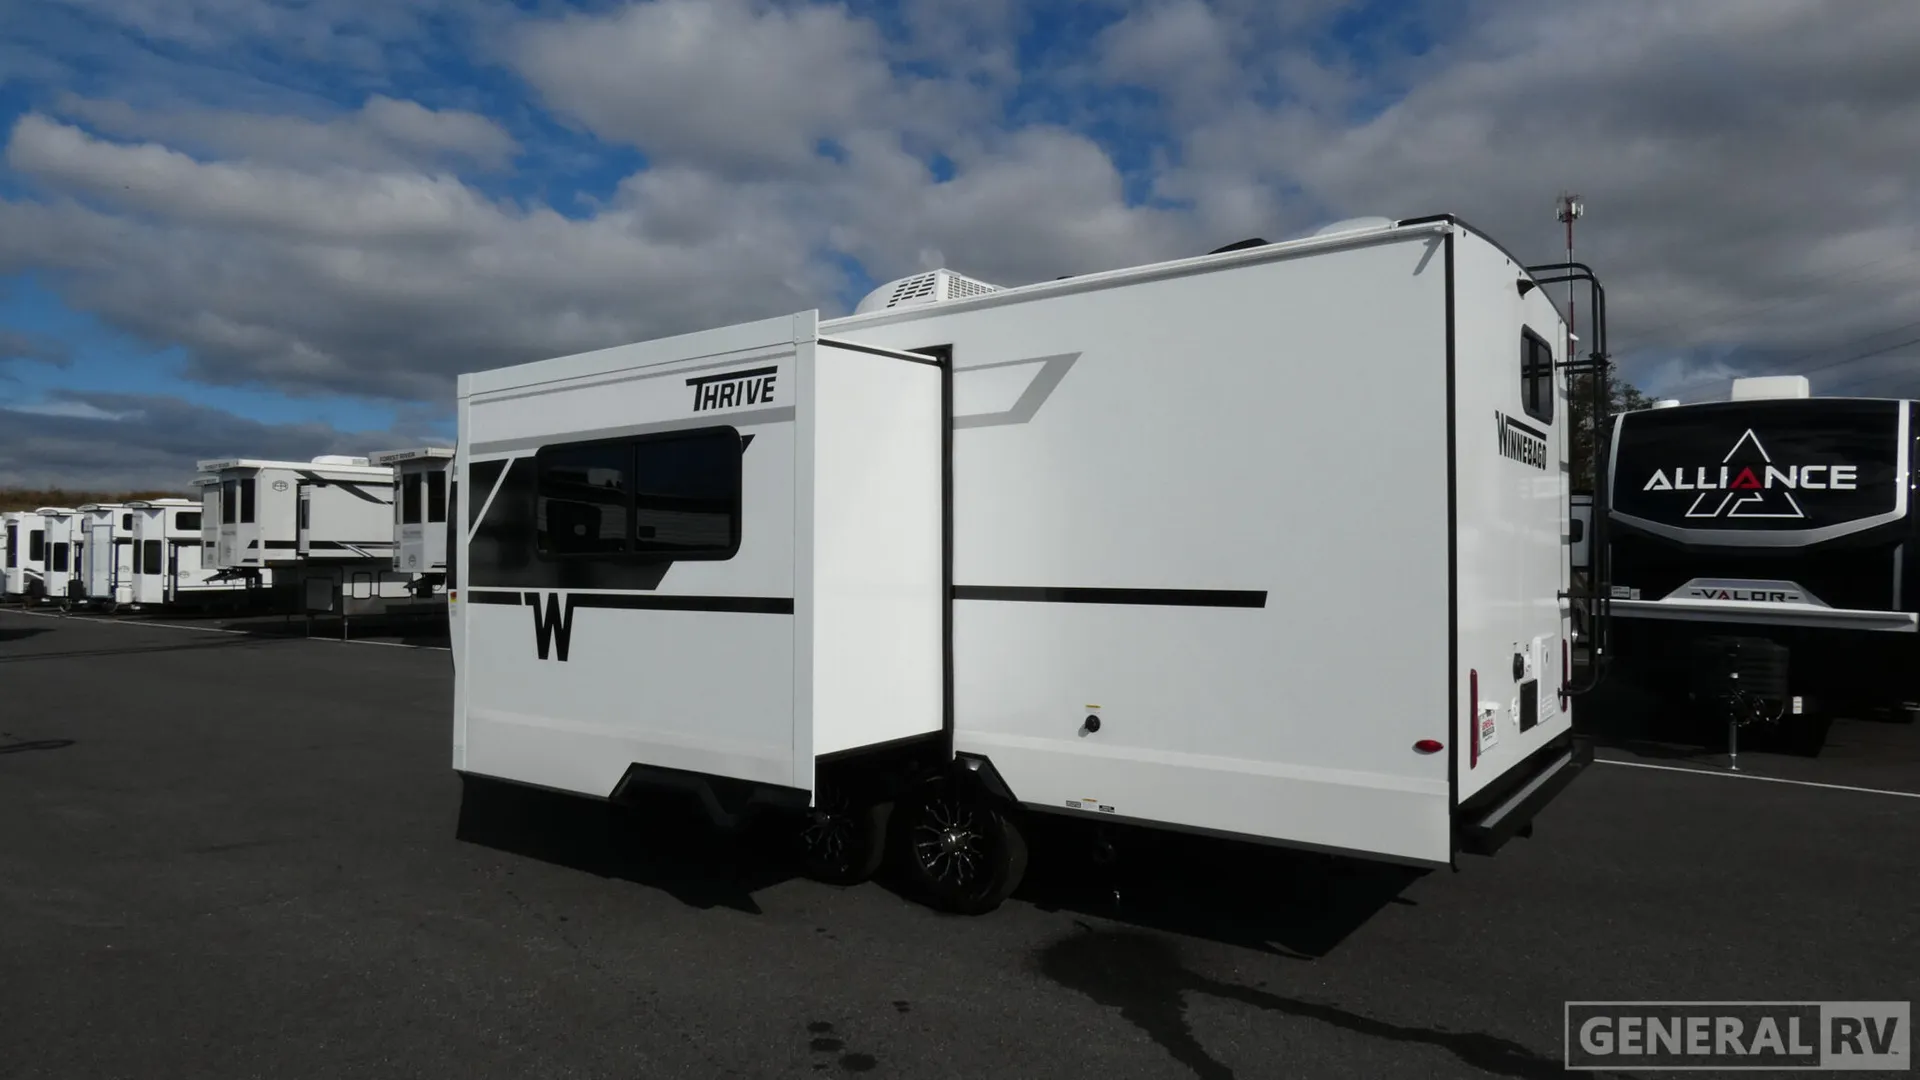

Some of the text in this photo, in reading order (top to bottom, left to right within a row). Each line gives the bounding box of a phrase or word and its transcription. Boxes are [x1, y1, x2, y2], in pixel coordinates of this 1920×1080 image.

[685, 365, 778, 411] THRIVE
[1495, 409, 1547, 471] WINNEBAGO
[1643, 465, 1857, 491] ALLIANCE
